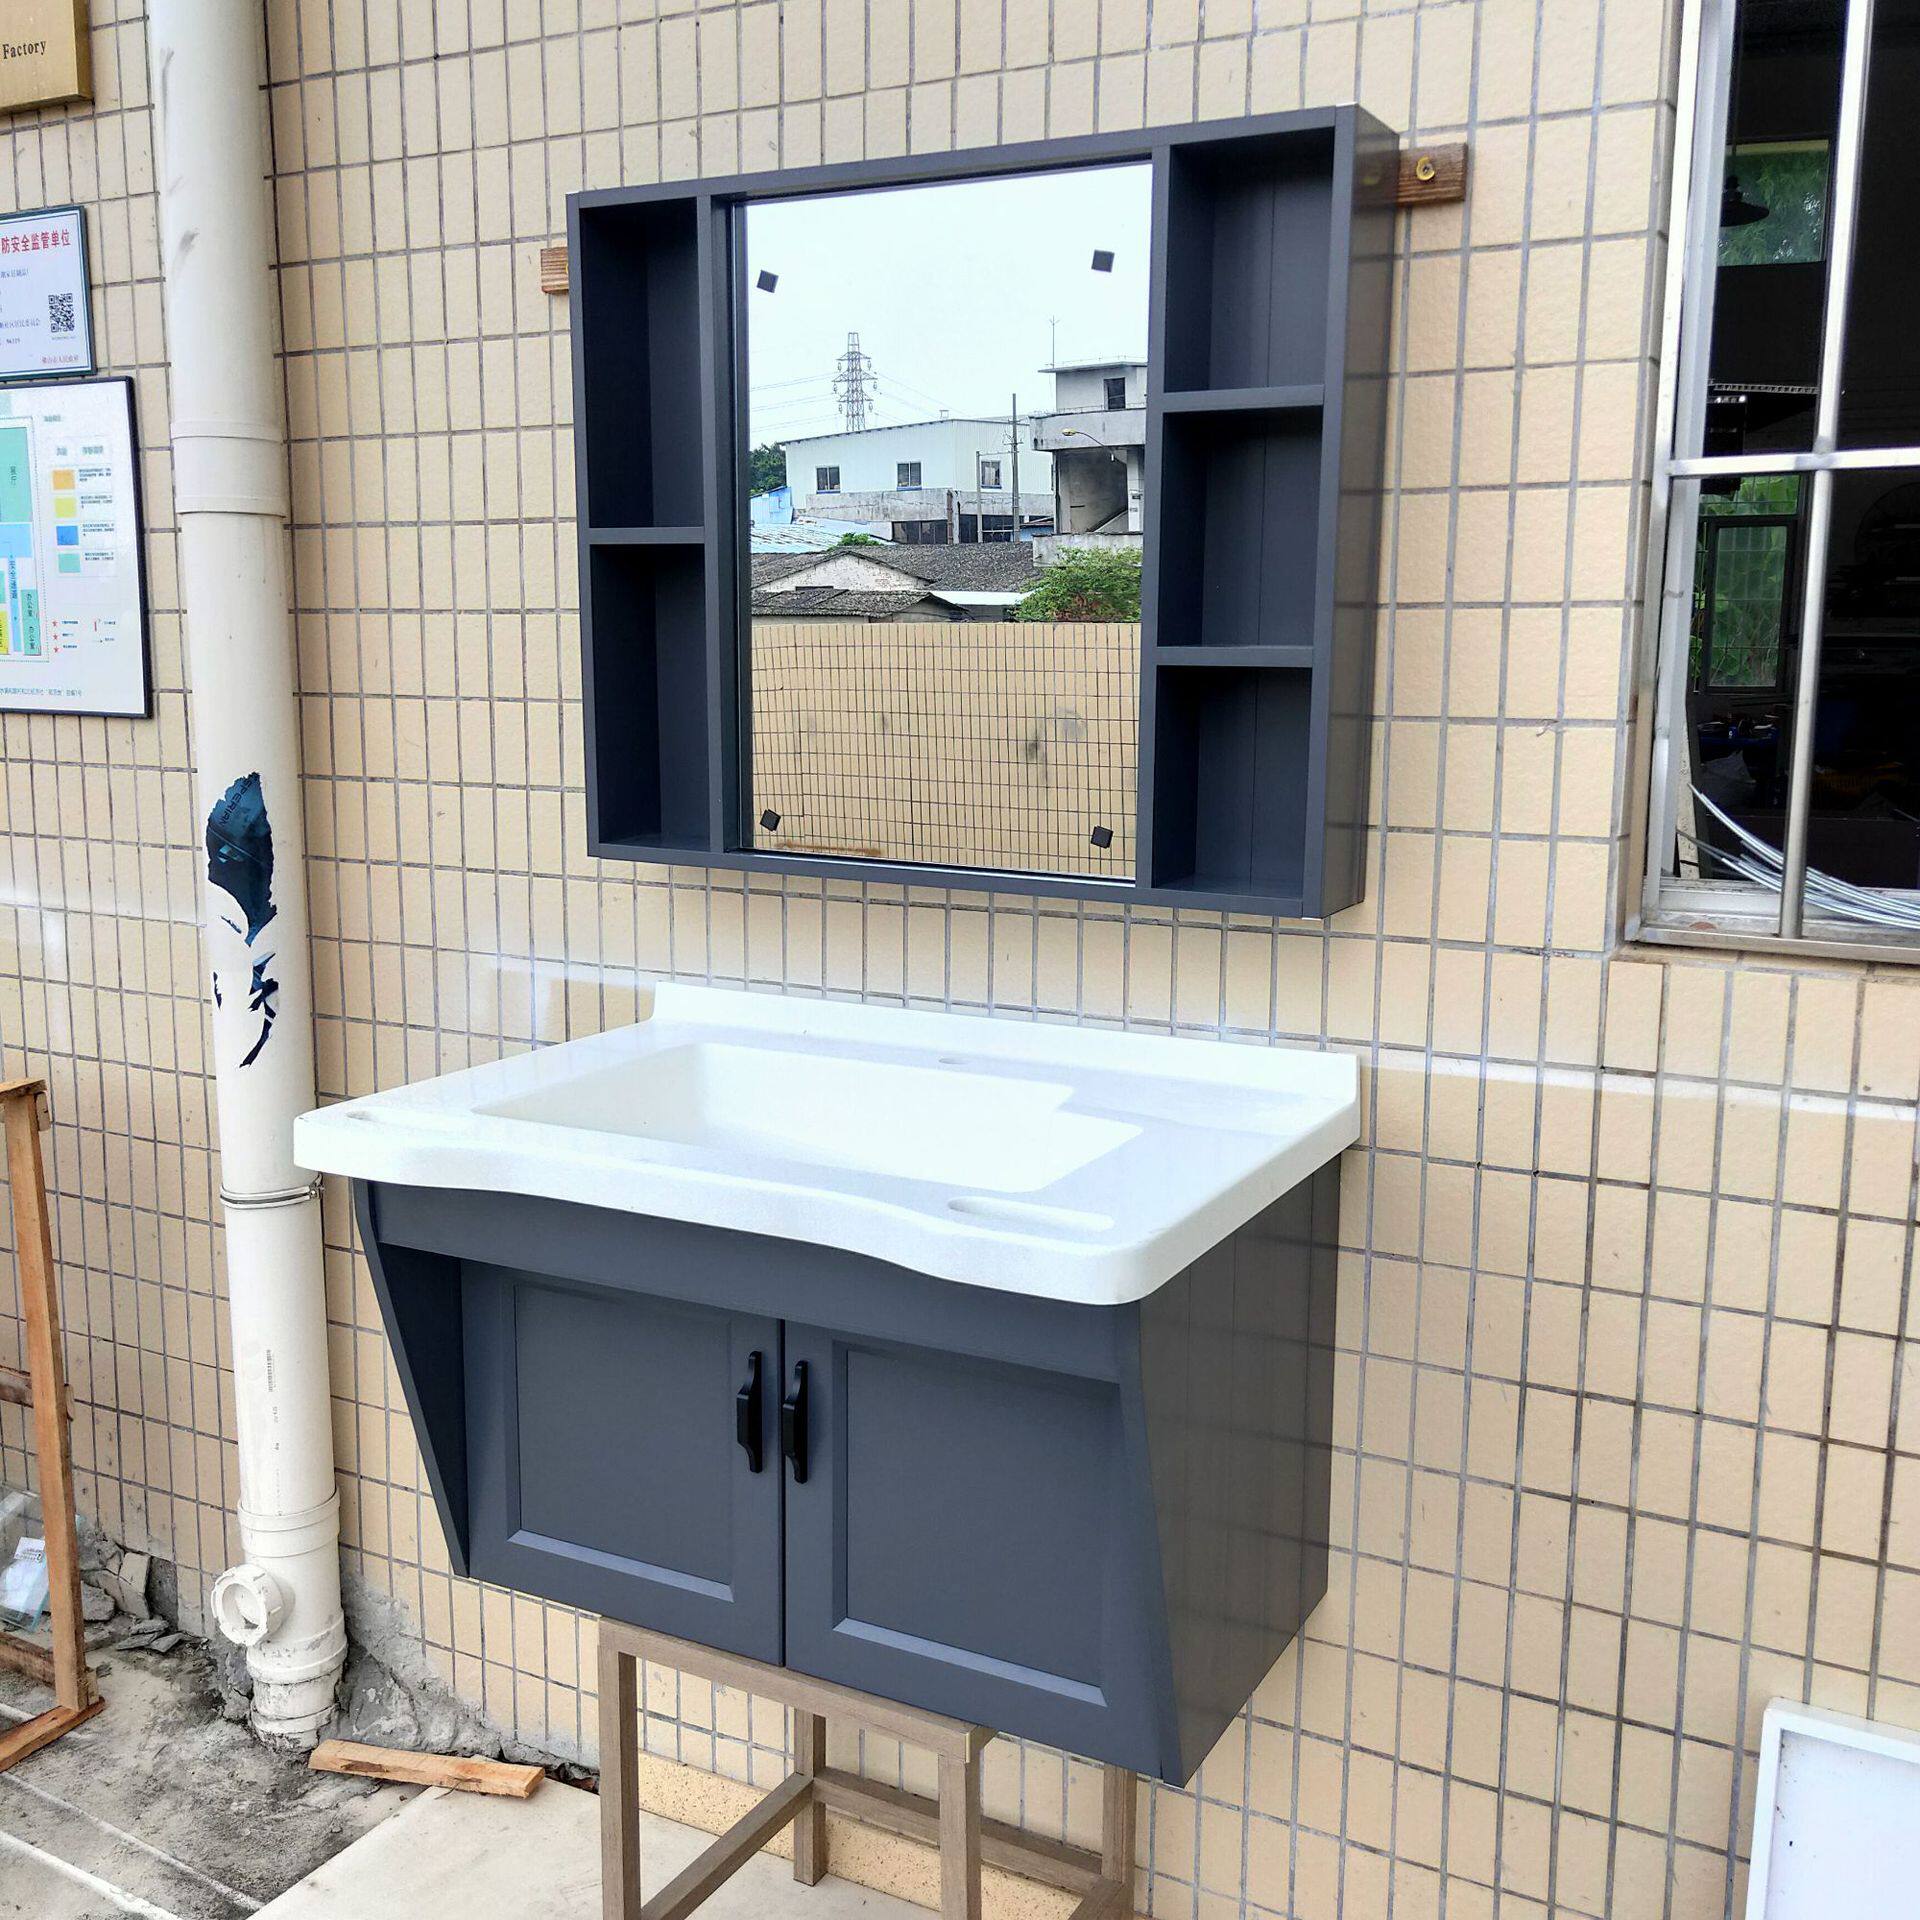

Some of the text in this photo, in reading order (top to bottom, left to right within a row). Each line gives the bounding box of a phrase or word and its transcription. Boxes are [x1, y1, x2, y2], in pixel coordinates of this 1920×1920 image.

[2, 41, 46, 59] Factory
[1, 229, 71, 254] 防安全监管单位
